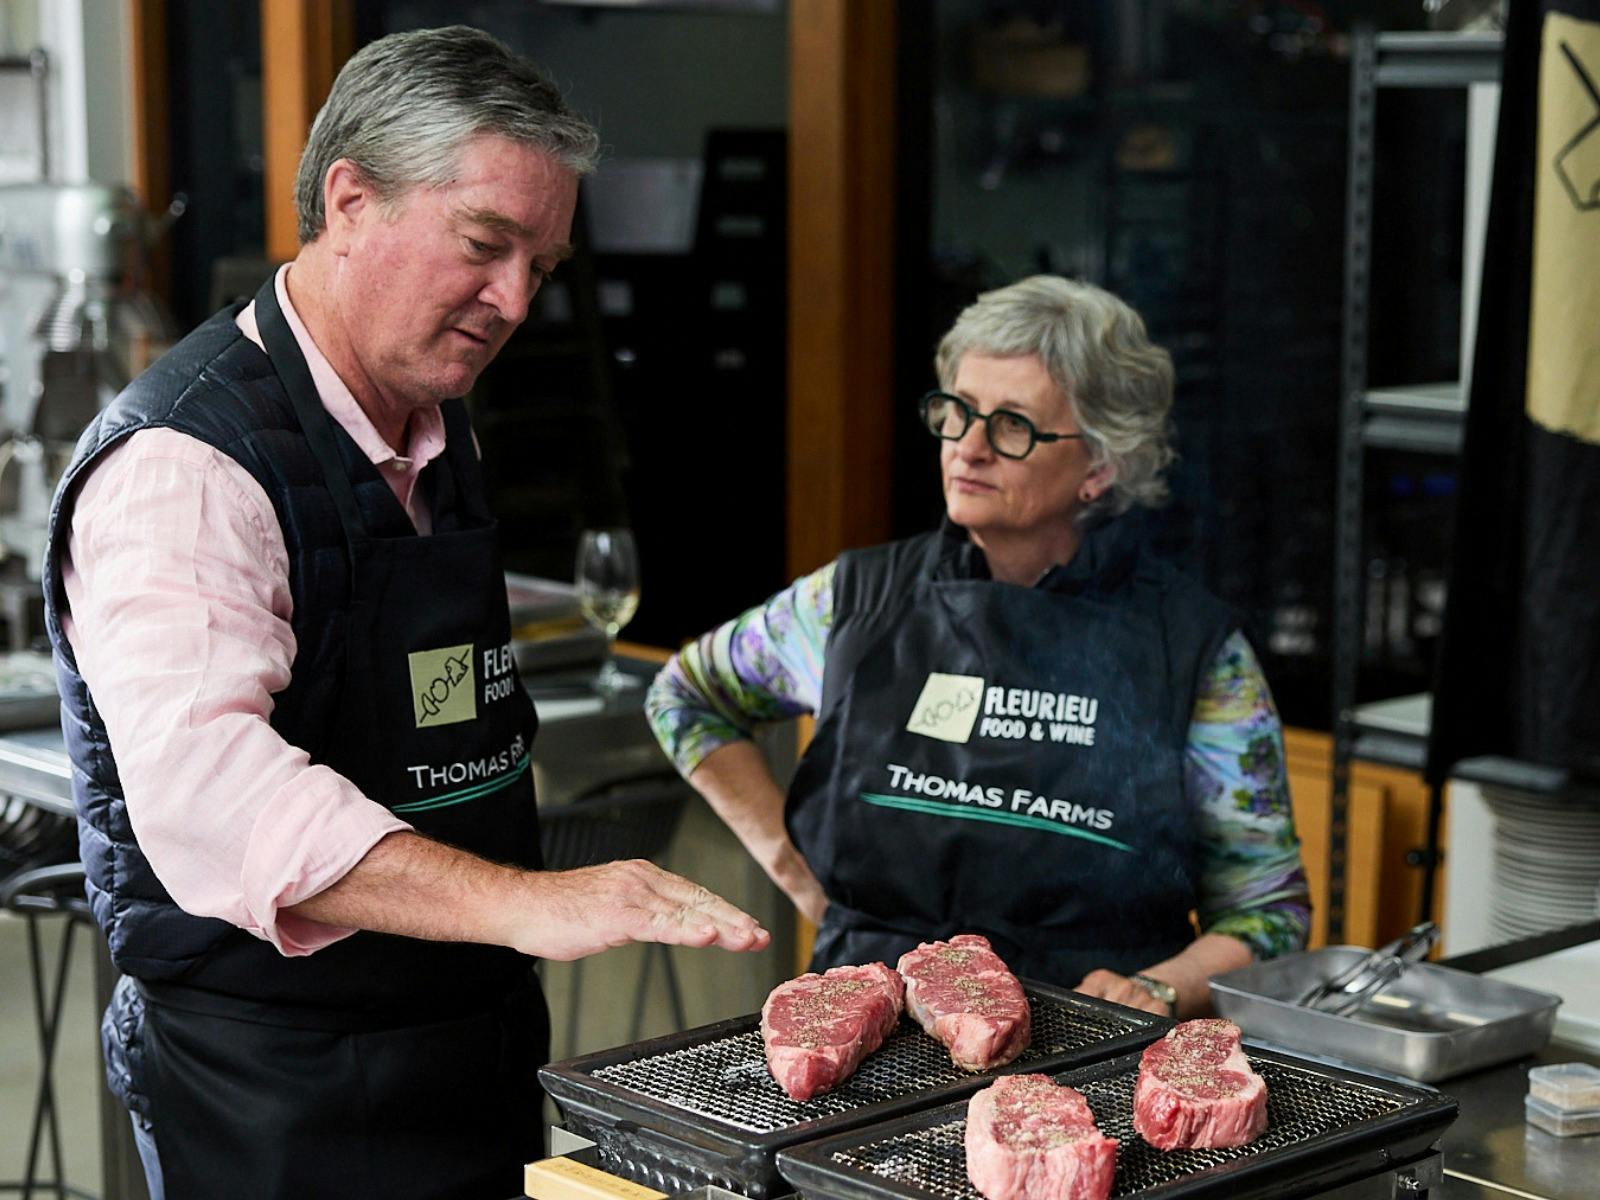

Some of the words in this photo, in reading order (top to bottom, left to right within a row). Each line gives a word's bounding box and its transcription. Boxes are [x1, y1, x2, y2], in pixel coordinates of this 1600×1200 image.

[984, 686, 1099, 725] FLEURIEU
[979, 717, 1026, 739] FOOD
[1029, 721, 1045, 741] &
[1049, 722, 1096, 746] WINE
[407, 751, 509, 788] THOMAS
[887, 763, 1004, 808] THOMAS
[1011, 789, 1115, 830] FARMS
